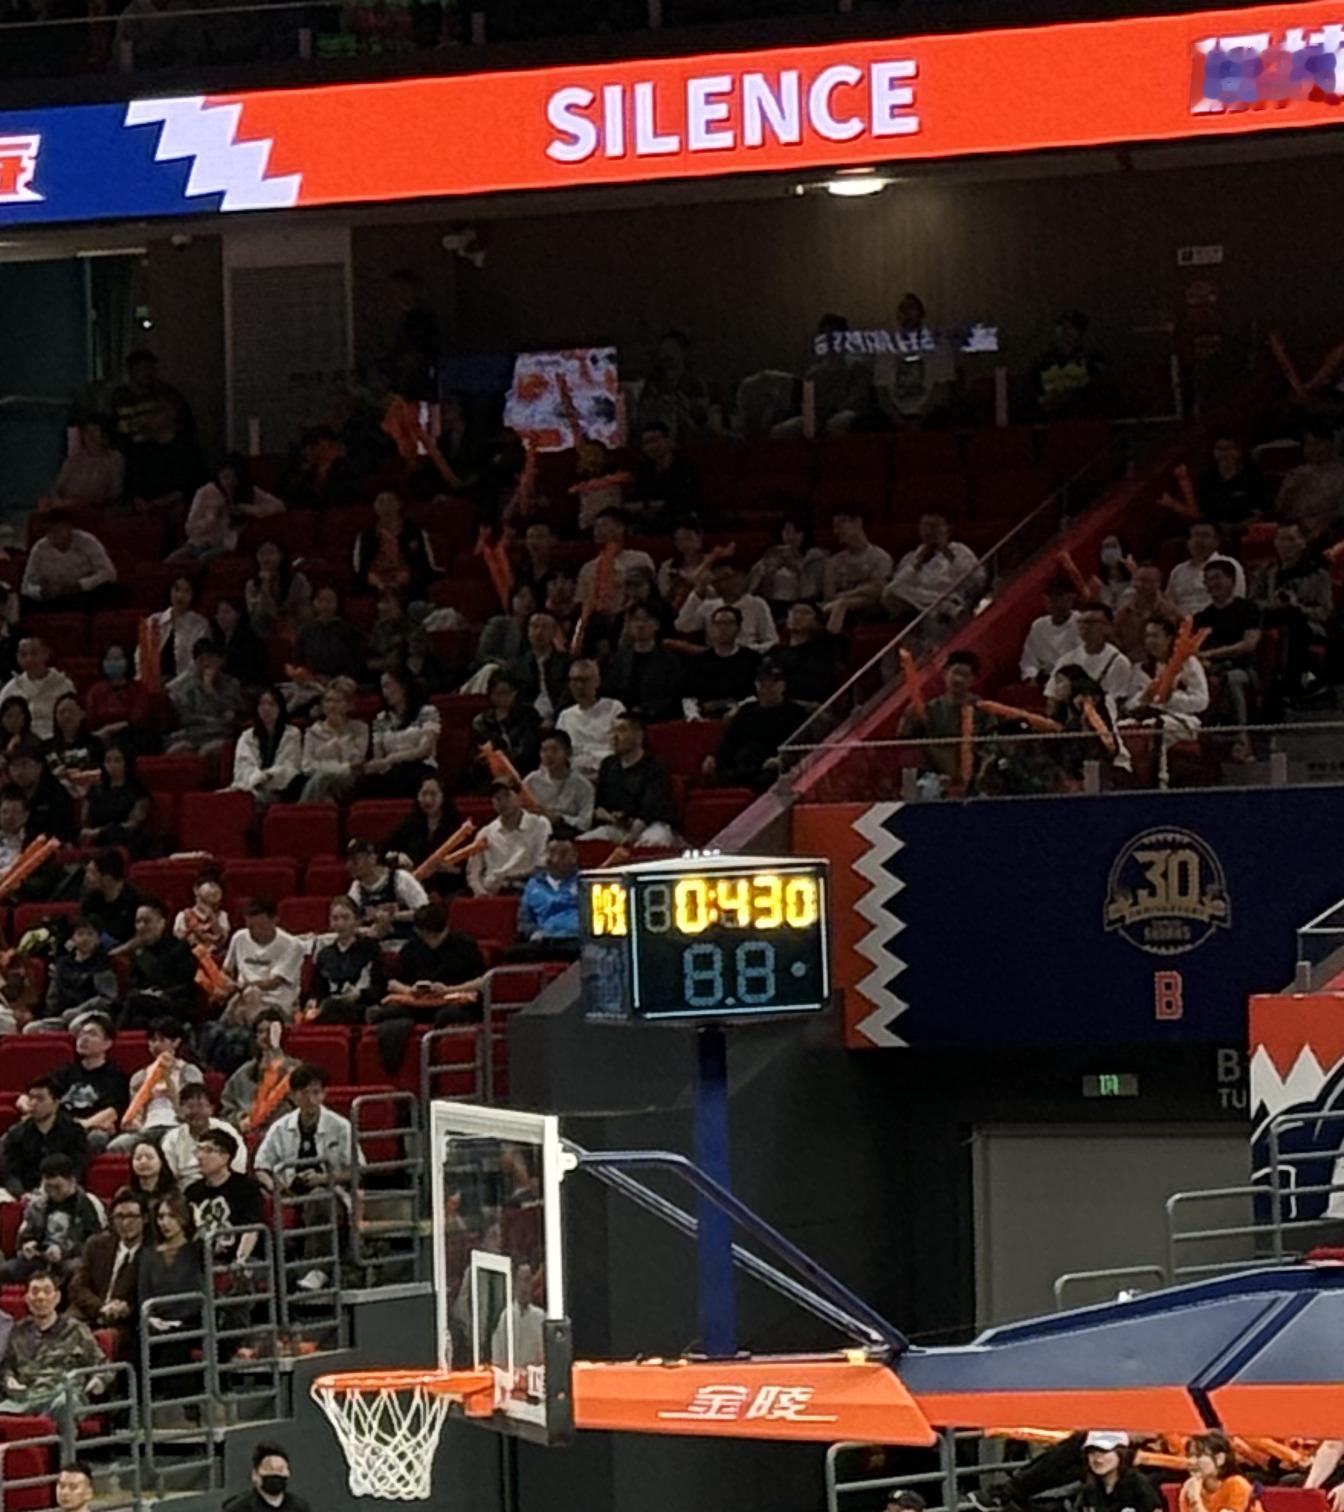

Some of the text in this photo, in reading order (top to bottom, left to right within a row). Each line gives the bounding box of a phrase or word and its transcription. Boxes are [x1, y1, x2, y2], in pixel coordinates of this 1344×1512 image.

[547, 60, 920, 163] SILENCE
[1132, 849, 1200, 904] 30
[1154, 971, 1183, 1021] B
[658, 1385, 838, 1422] 金陵
